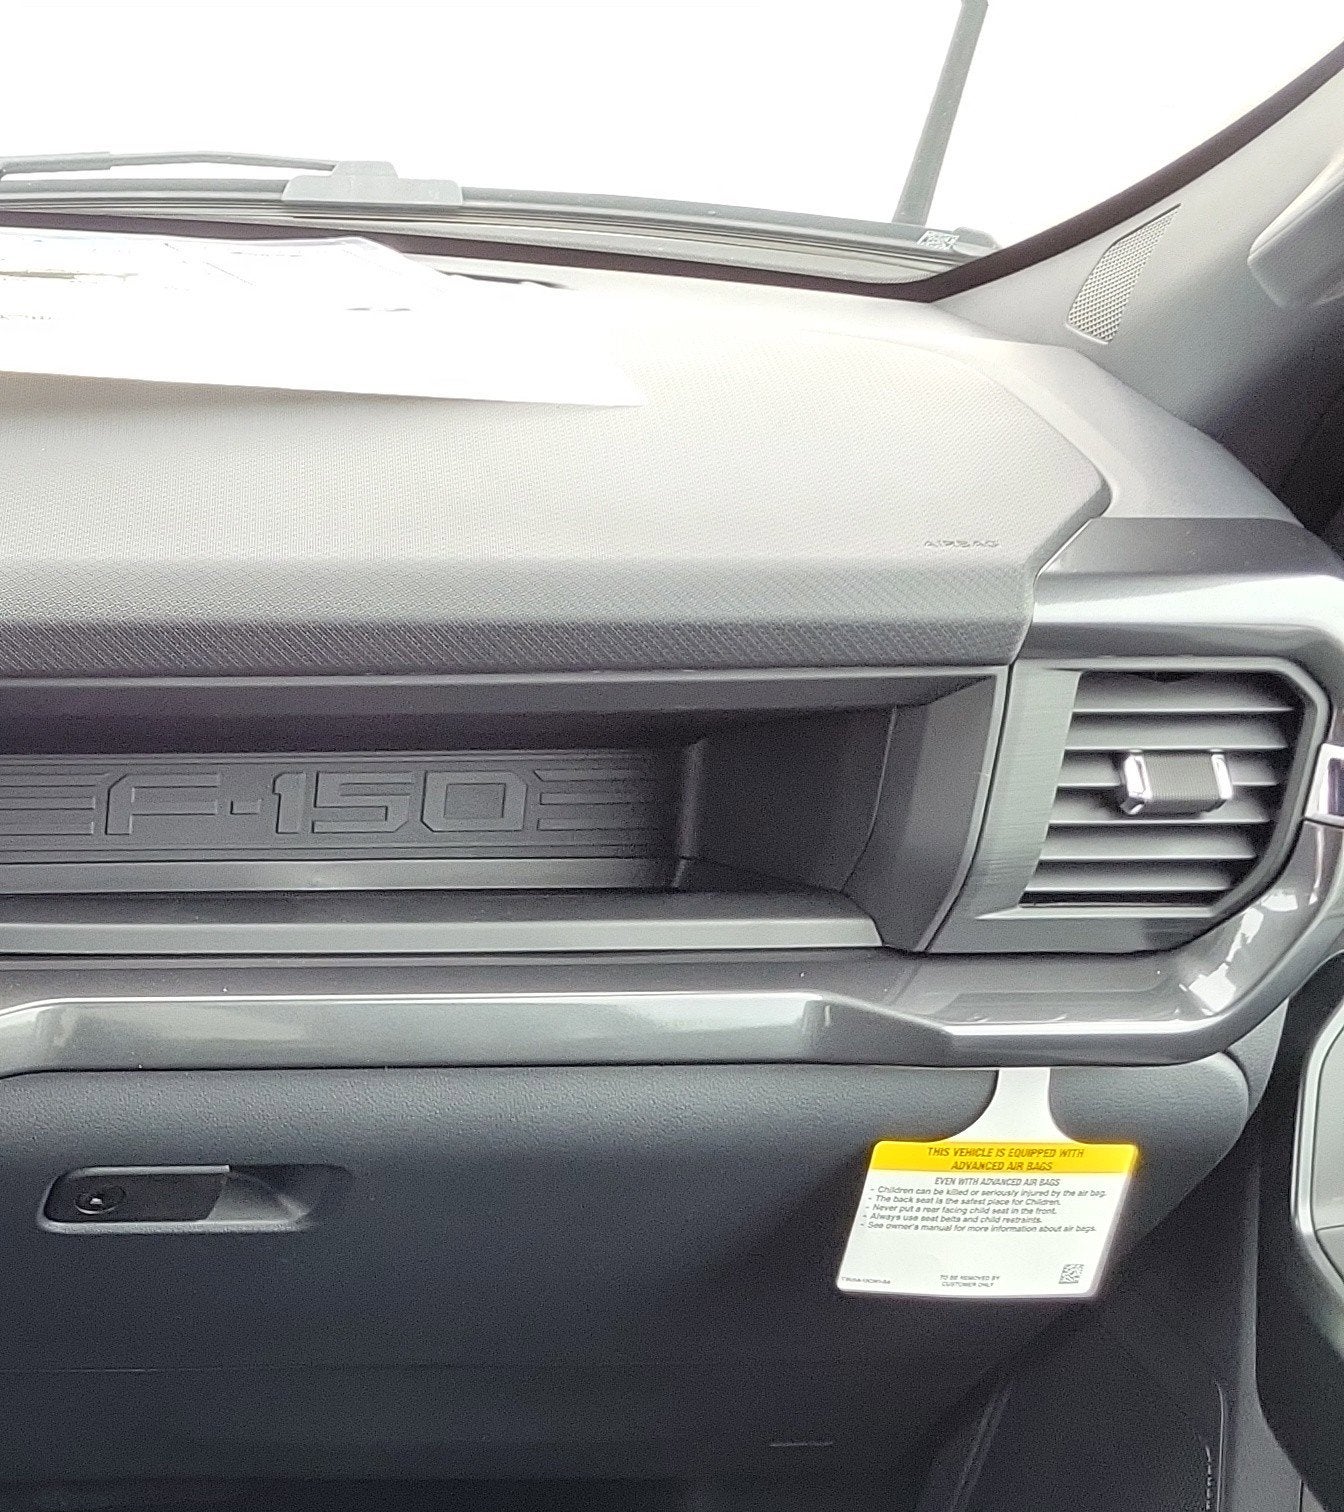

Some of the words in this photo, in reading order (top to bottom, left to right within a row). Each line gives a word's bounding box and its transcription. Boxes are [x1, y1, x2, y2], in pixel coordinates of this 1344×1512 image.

[105, 770, 529, 837] F-150
[928, 1147, 950, 1157] THIS
[953, 1148, 993, 1158] VEHICLE
[995, 1148, 1005, 1158] IS
[1008, 1148, 1057, 1158] EQUIPPED
[1059, 1148, 1085, 1158] WITH
[950, 1161, 1004, 1171] ADVANCED
[1007, 1161, 1024, 1171] AIR
[1026, 1161, 1053, 1171] BAGS
[934, 1177, 955, 1185] EVEN
[958, 1178, 979, 1186] WITH
[980, 1178, 1022, 1186] ADVANCED
[1023, 1178, 1037, 1186] AIR
[1039, 1178, 1060, 1186] BAGS
